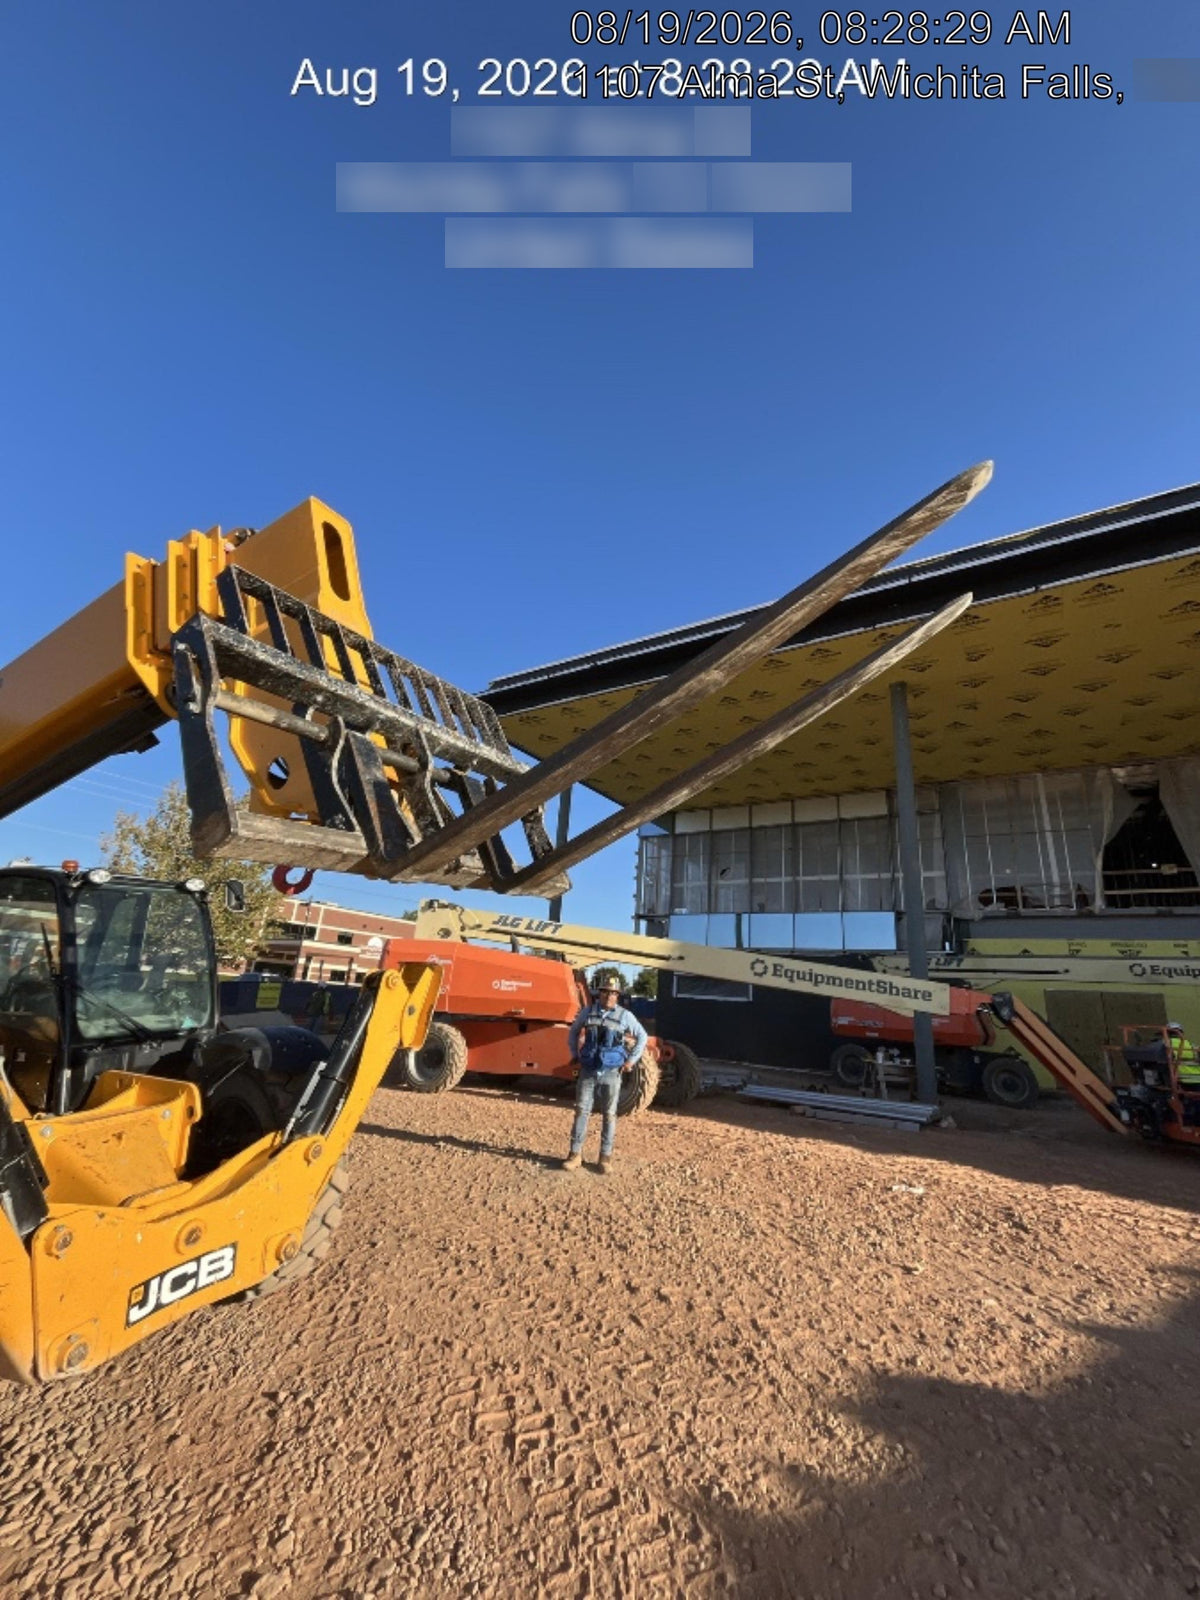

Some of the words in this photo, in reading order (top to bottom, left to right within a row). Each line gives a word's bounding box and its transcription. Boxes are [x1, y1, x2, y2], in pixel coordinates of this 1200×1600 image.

[524, 919, 563, 935] LIFT
[771, 963, 933, 1002] EquipmentShare
[127, 1245, 236, 1325] JCB
